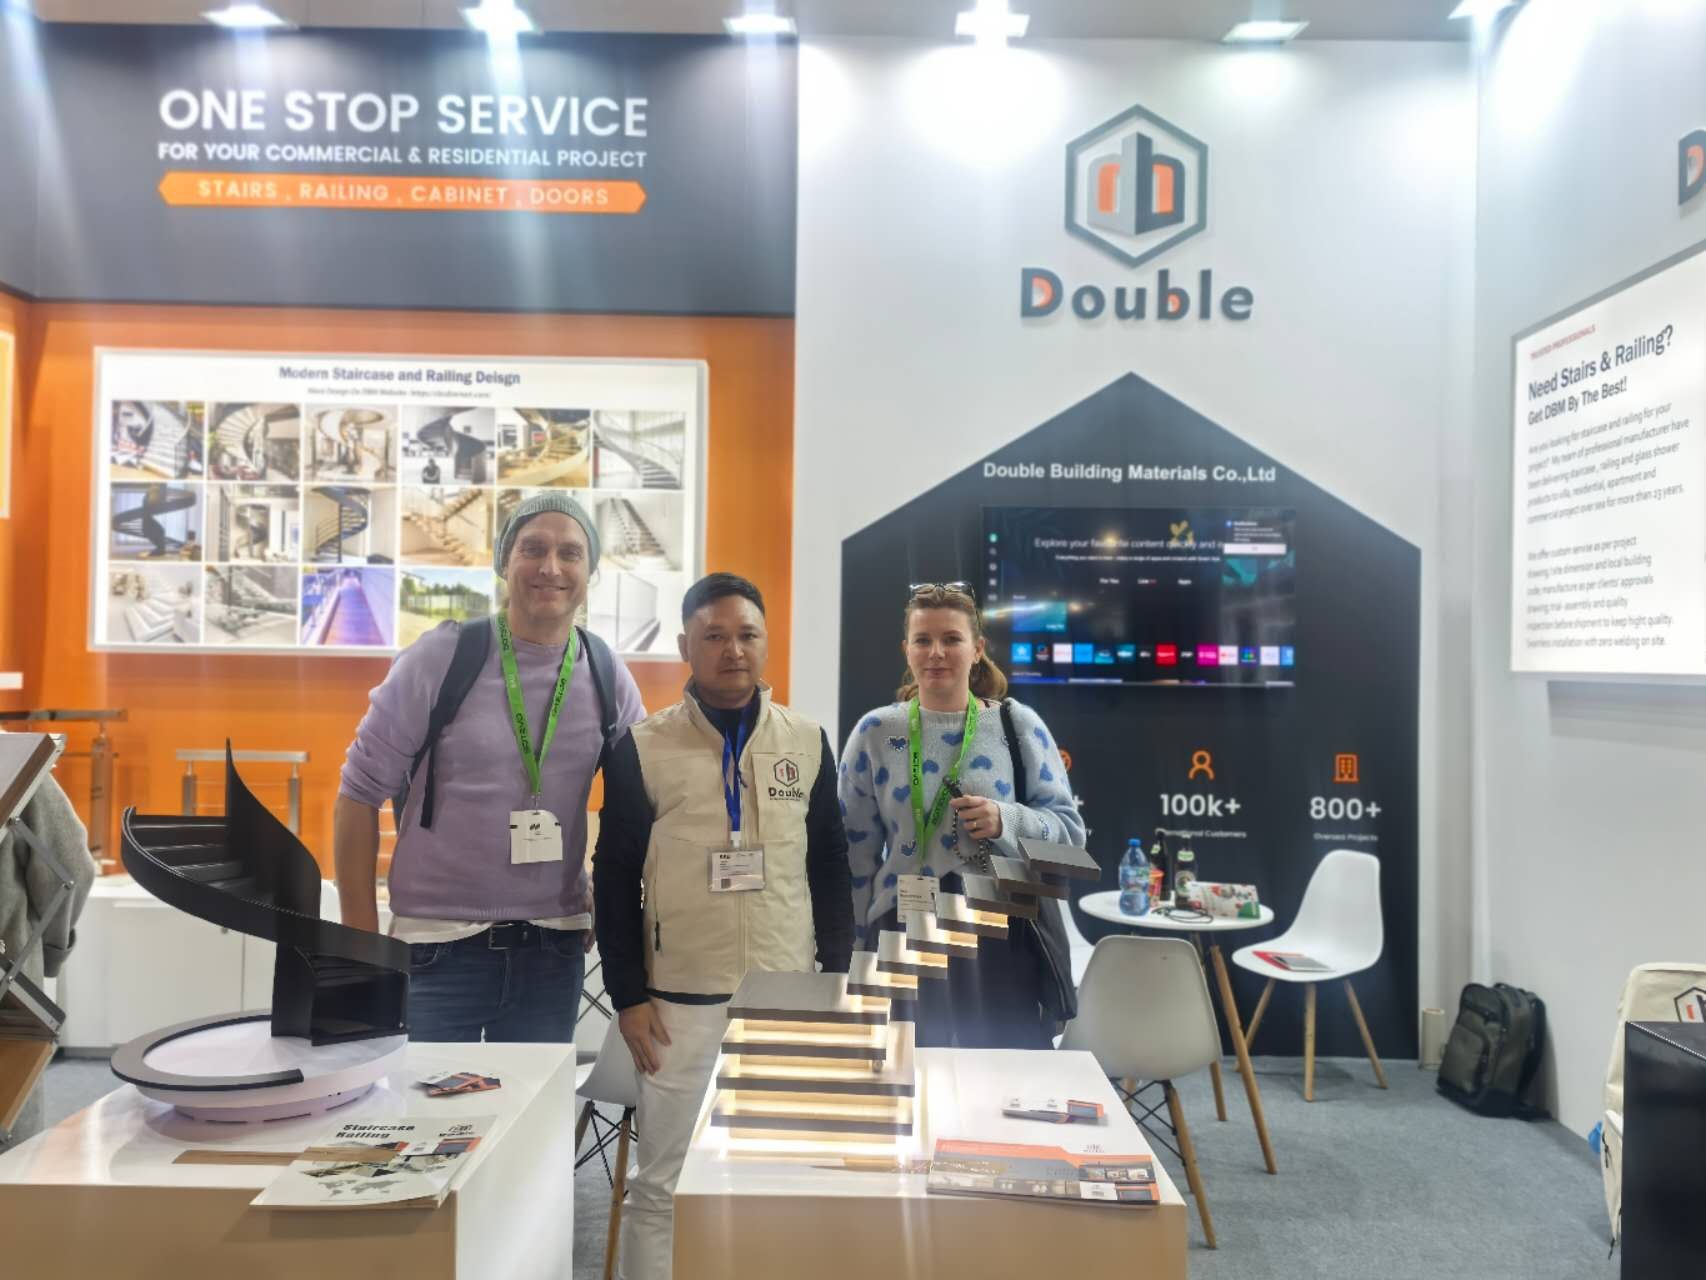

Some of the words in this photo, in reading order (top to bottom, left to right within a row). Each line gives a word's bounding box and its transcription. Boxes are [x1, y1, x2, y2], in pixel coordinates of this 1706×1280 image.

[160, 89, 266, 130] ONE
[284, 90, 419, 132] STOP
[438, 94, 648, 137] SERVICE
[158, 142, 198, 160] FOR
[204, 143, 260, 161] YOUR
[265, 144, 402, 163] COMMERCIAL
[408, 146, 422, 164] &
[428, 147, 552, 166] RESIDENTIAL
[557, 150, 648, 167] PROJECT
[197, 179, 278, 198] STAIRS
[300, 182, 389, 201] RAILING
[411, 185, 508, 204] CABINET
[530, 187, 608, 205] DOORS
[1020, 267, 1254, 320] Double
[1528, 372, 1557, 400] Need
[1561, 360, 1596, 388] Stairs
[1600, 351, 1611, 372] &
[1615, 324, 1673, 366] Railing?
[279, 366, 329, 380] Modern
[332, 367, 394, 381] Staircase
[398, 369, 422, 382] and
[426, 369, 472, 385] Railing
[476, 370, 521, 387] Deisgn
[1528, 410, 1543, 425] Get
[1544, 398, 1565, 420] DBM
[1568, 396, 1579, 412] By
[1582, 388, 1599, 406] The
[1602, 376, 1627, 399] Best!
[1644, 407, 1654, 418] for
[1655, 403, 1672, 419] your
[1671, 418, 1689, 431] have
[1621, 453, 1634, 465] and
[983, 462, 1045, 478] Double
[1050, 463, 1123, 483] Building
[1128, 464, 1207, 481] Materials
[1212, 466, 1276, 482] Co.,Ltd
[1643, 467, 1656, 480] and
[1636, 490, 1653, 503] than
[1623, 554, 1652, 568] building
[1160, 794, 1241, 816] 100k+
[1310, 796, 1381, 819] 800+
